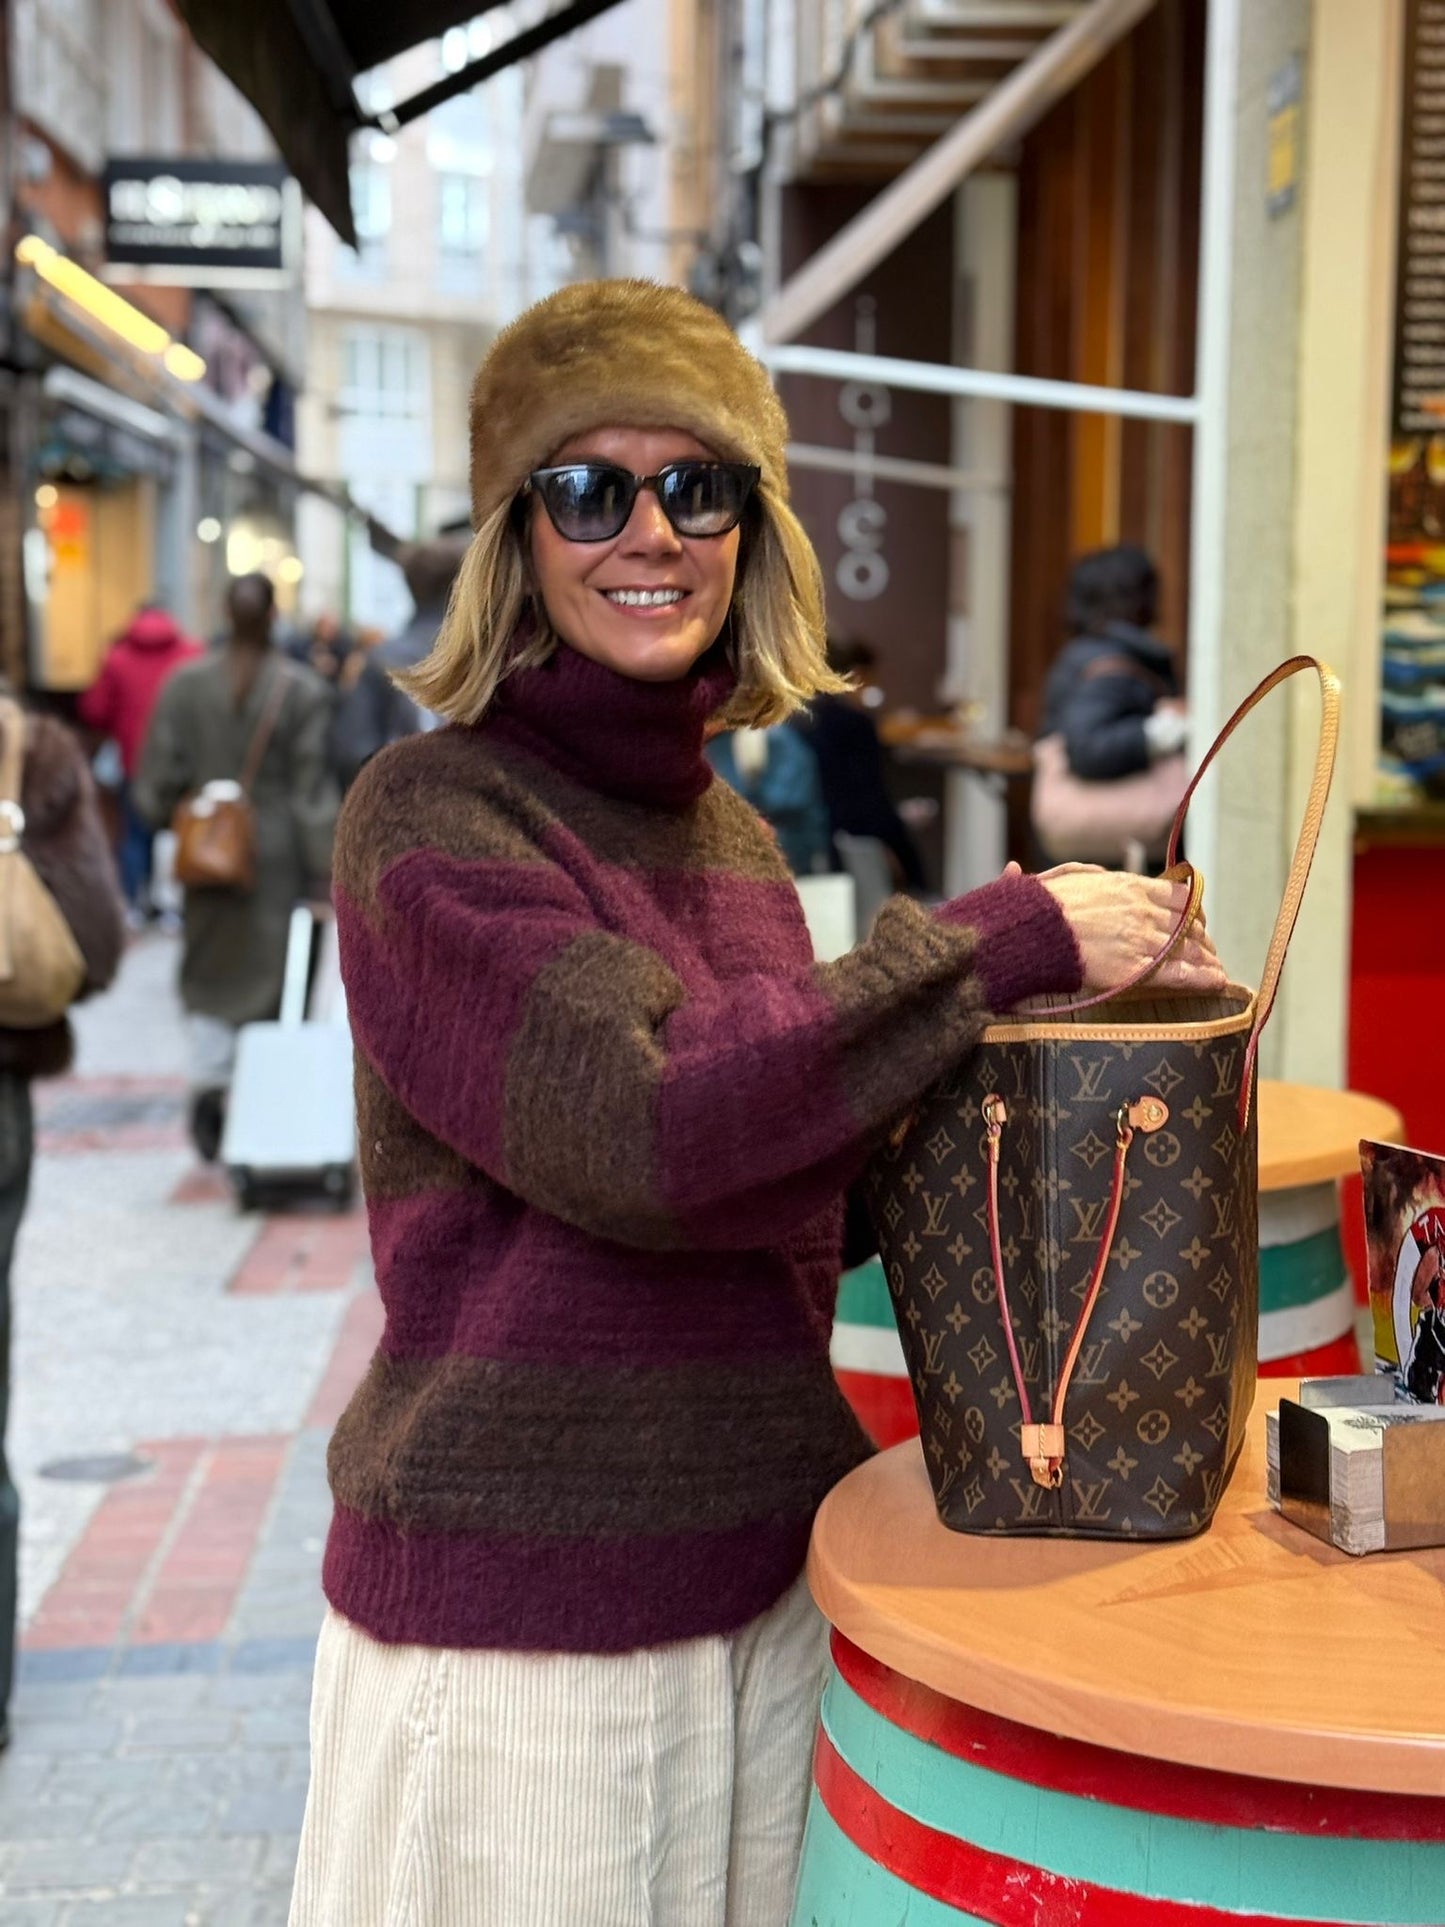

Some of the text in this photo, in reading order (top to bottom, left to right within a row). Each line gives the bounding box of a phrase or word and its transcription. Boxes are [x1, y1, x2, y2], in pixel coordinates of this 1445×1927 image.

[1070, 1056, 1113, 1101] LV
[1211, 1048, 1237, 1098] LV
[921, 1190, 951, 1235] LV
[1069, 1196, 1110, 1242] LV
[1211, 1189, 1234, 1239] LV
[920, 1327, 947, 1373] LV
[1205, 1326, 1232, 1378] LV
[1071, 1477, 1113, 1520] LV
